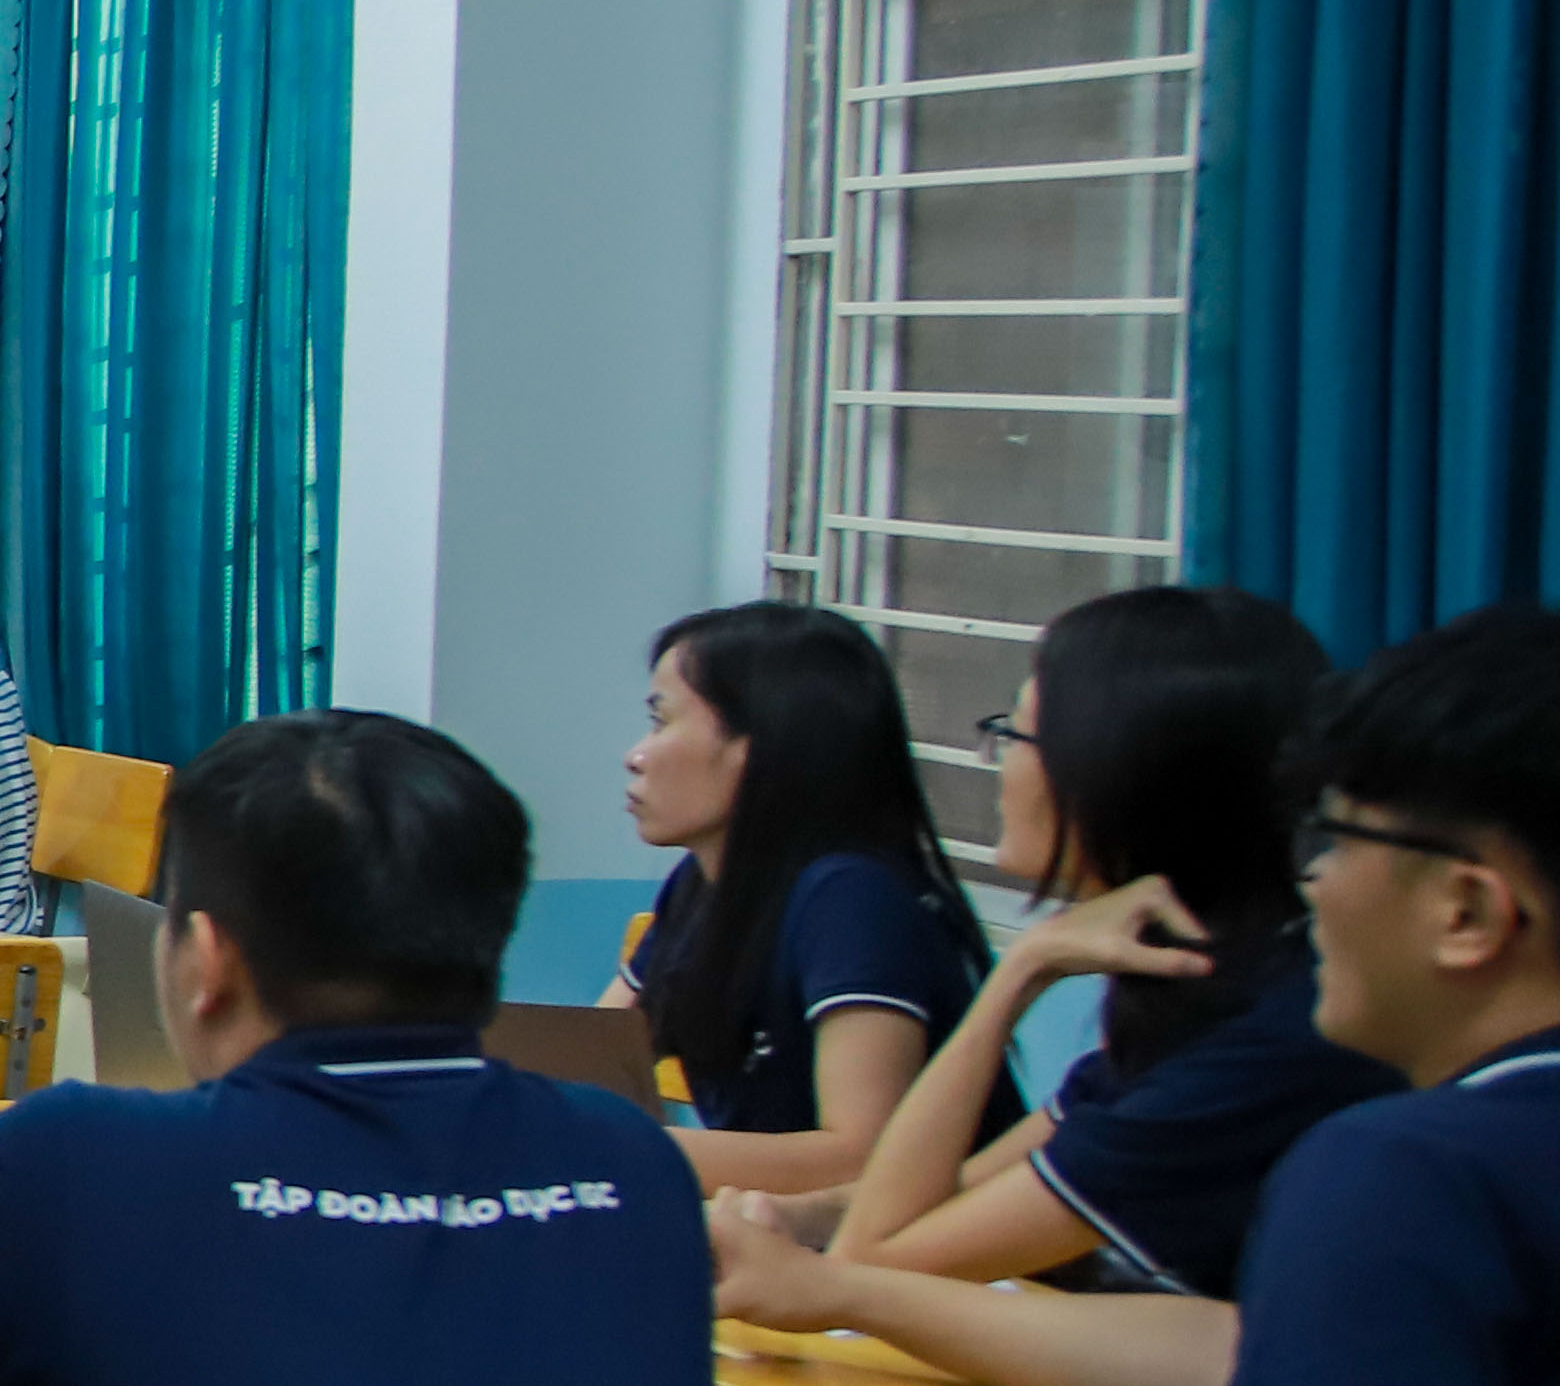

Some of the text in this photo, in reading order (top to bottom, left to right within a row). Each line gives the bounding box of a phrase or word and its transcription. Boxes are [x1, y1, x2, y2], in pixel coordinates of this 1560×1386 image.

[231, 1177, 575, 1224] TẬP ĐOÀN DỤC
